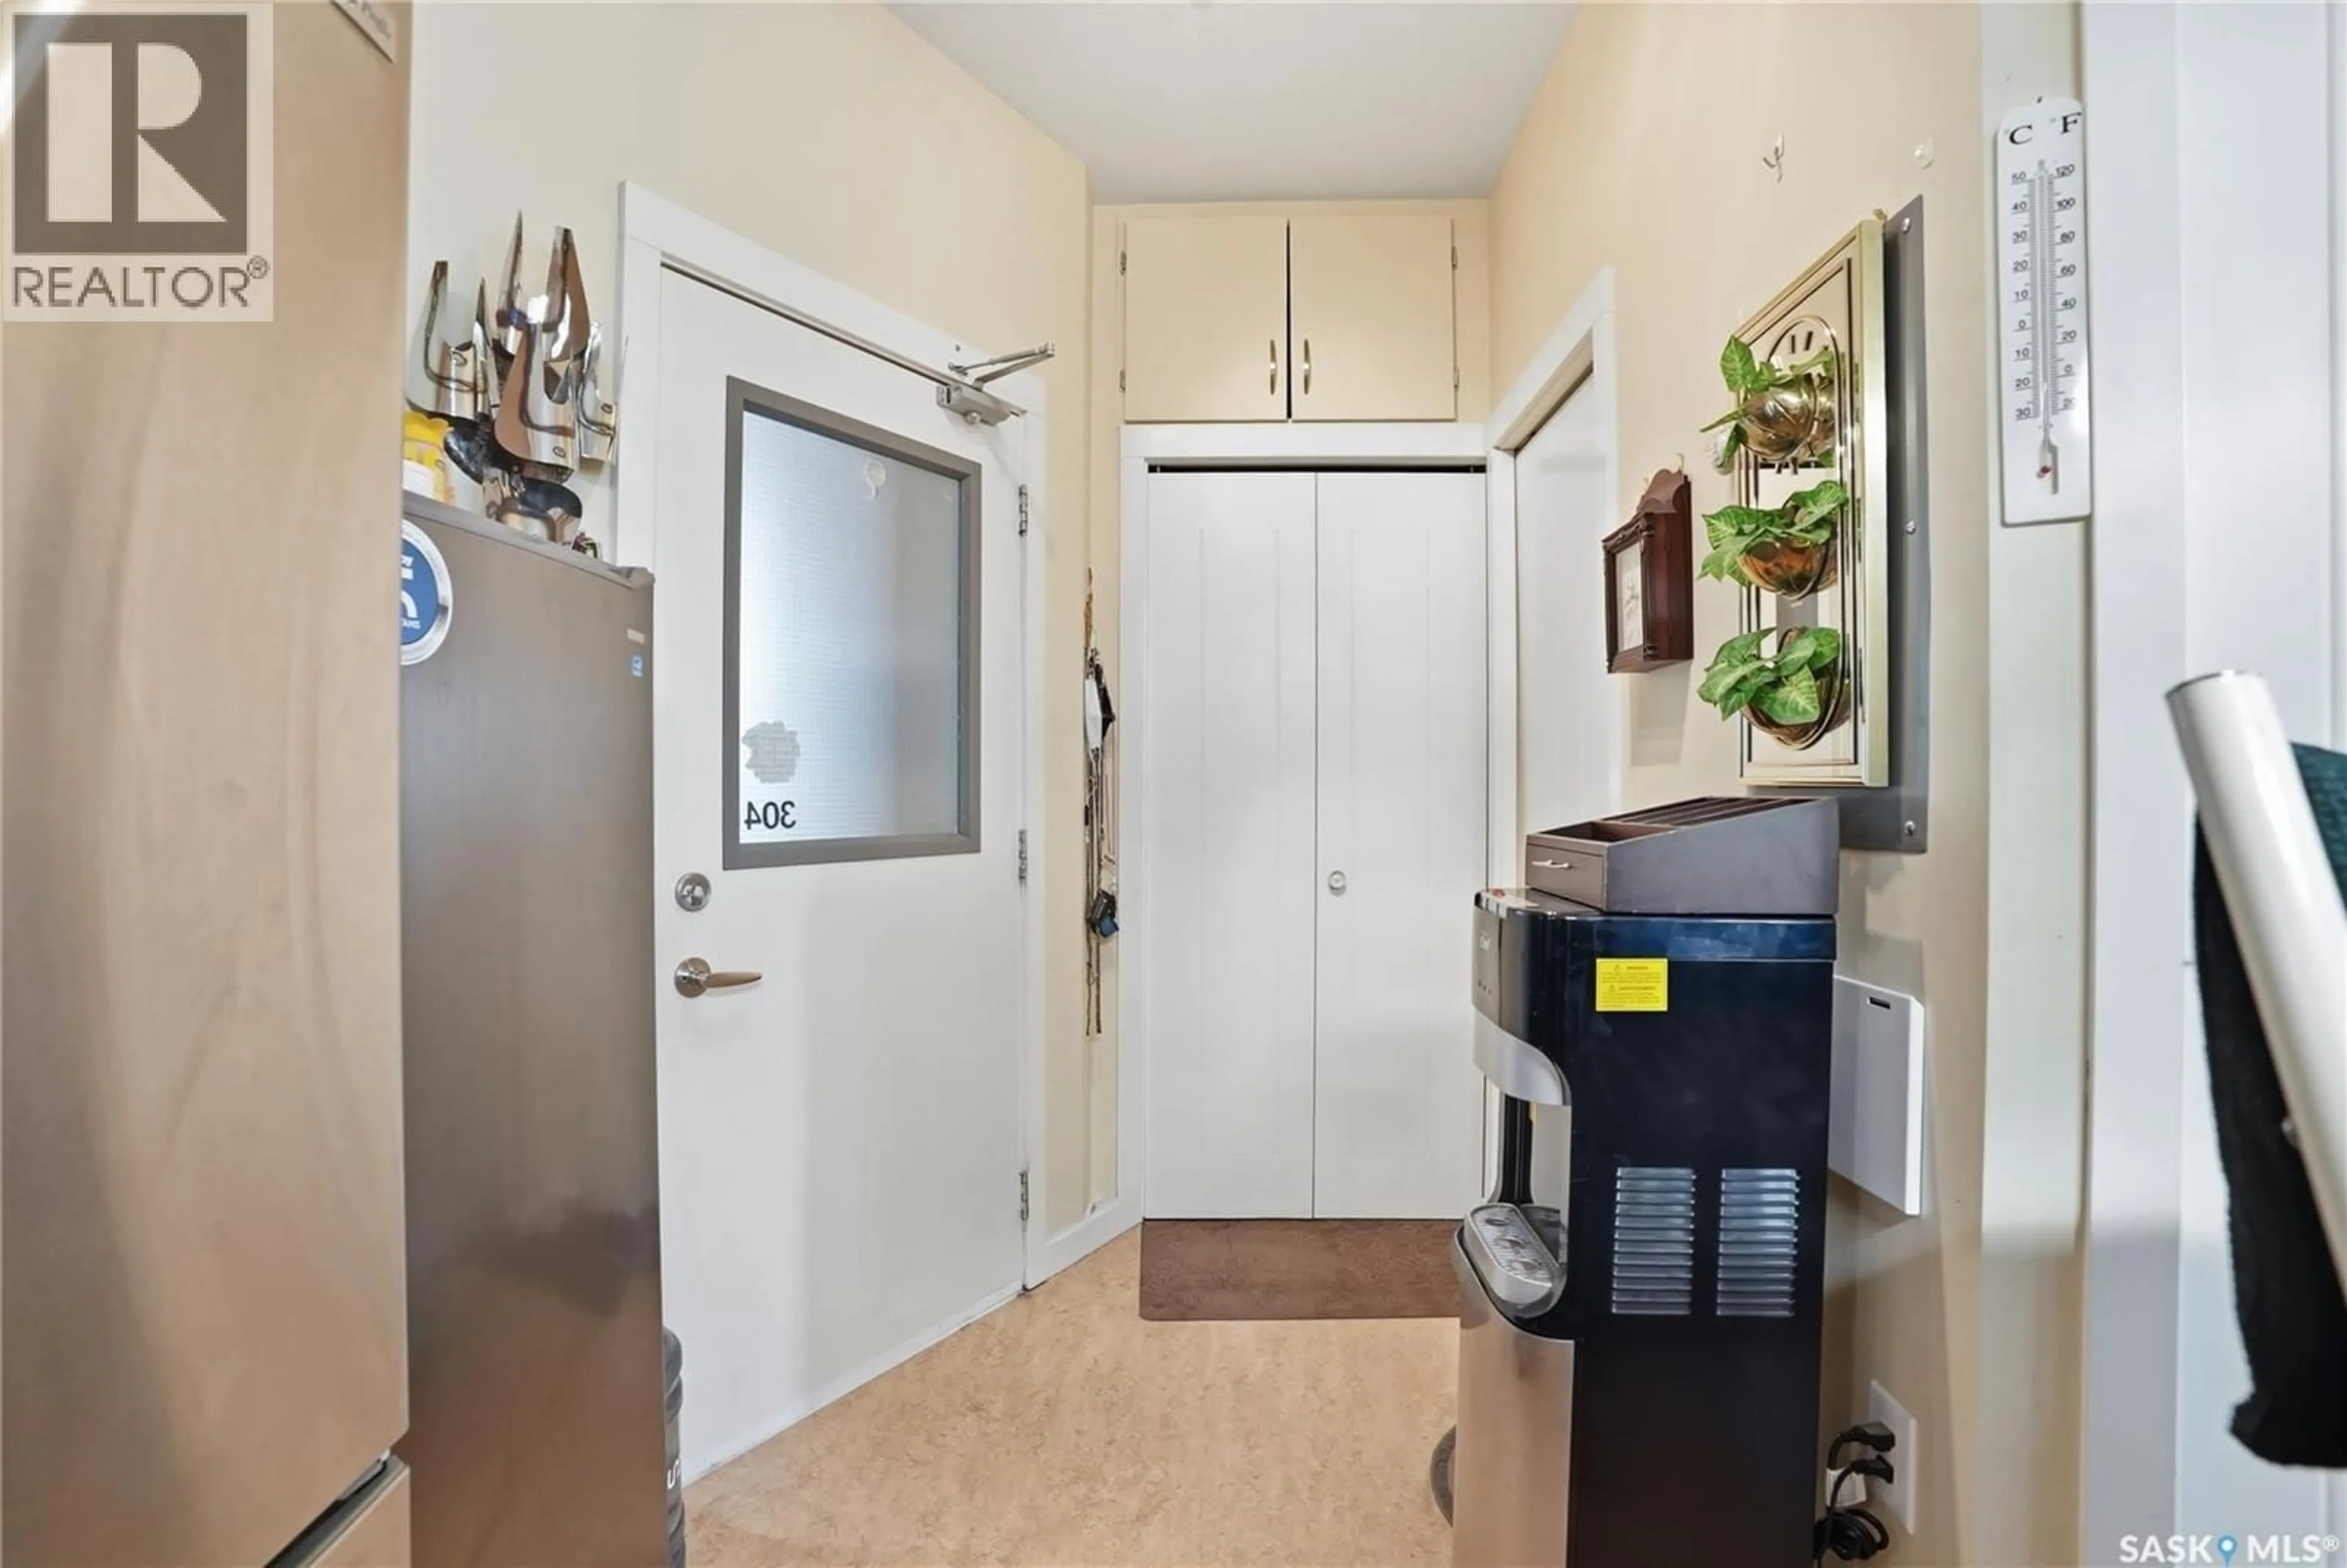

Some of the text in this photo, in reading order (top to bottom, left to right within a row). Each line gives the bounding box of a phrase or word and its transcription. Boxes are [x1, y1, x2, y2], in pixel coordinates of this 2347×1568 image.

[2060, 112, 2082, 134] F
[2008, 125, 2033, 145] C
[2055, 164, 2076, 177] 120
[2011, 171, 2027, 183] 50
[2011, 201, 2027, 211] 40
[2056, 197, 2076, 208] 100
[2060, 230, 2076, 243] 80
[2013, 260, 2028, 271] 20
[2060, 264, 2076, 276] 60
[2015, 289, 2029, 299] 10
[2062, 297, 2076, 310] 40
[2018, 320, 2026, 329] 0
[2062, 330, 2076, 342] 20
[2015, 347, 2030, 357] 10
[2065, 364, 2072, 373] 0
[2016, 377, 2030, 389] 20
[2016, 408, 2030, 419] 30
